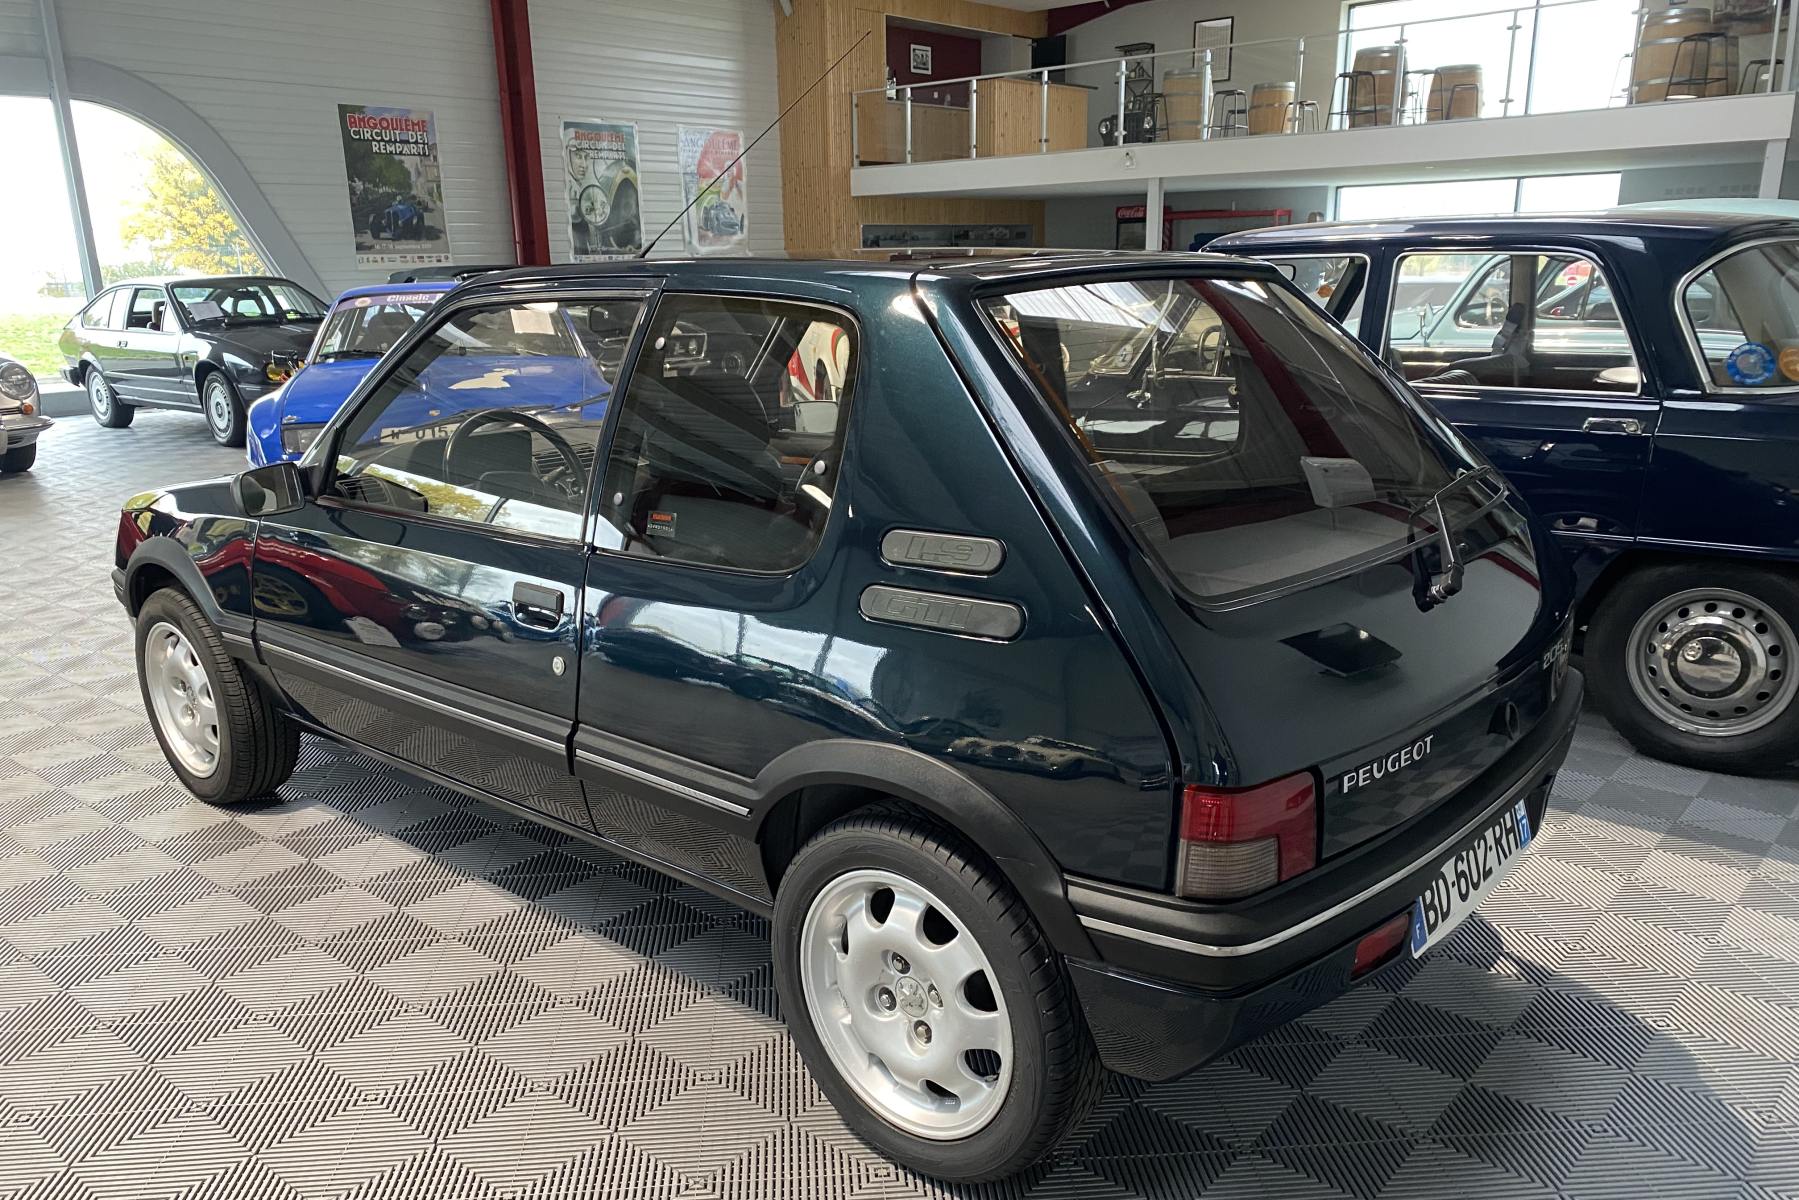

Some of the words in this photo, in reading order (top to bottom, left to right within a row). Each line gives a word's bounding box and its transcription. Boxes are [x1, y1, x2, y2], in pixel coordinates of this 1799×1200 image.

[350, 128, 401, 141] CIRCUIT
[371, 141, 429, 156] REMPARTS
[871, 590, 974, 629] GTI
[1343, 734, 1434, 794] PEUGEOT
